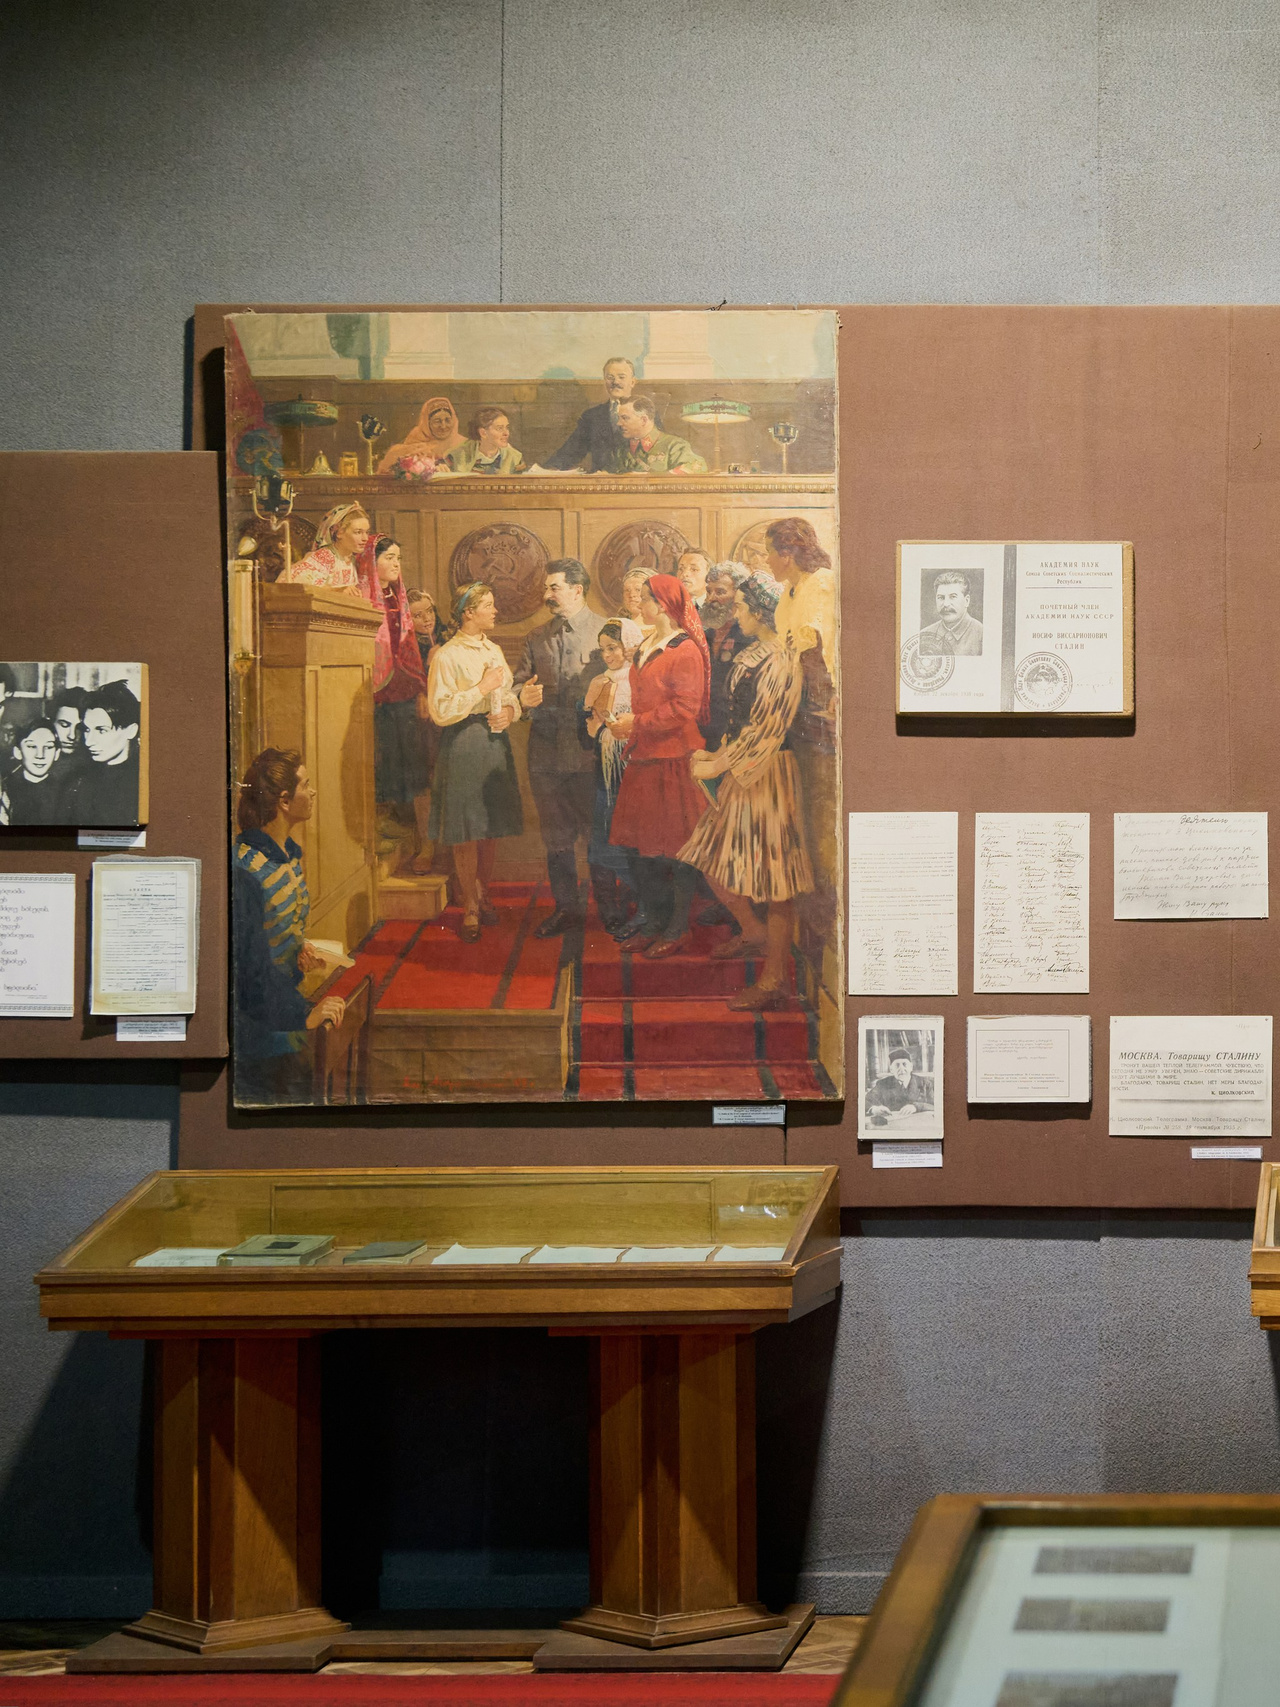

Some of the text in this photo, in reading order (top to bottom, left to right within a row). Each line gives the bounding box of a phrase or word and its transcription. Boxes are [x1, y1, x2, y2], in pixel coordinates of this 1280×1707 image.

[1119, 1052, 1261, 1062] МОСКВА. Товарищу СТАЛИНУ
